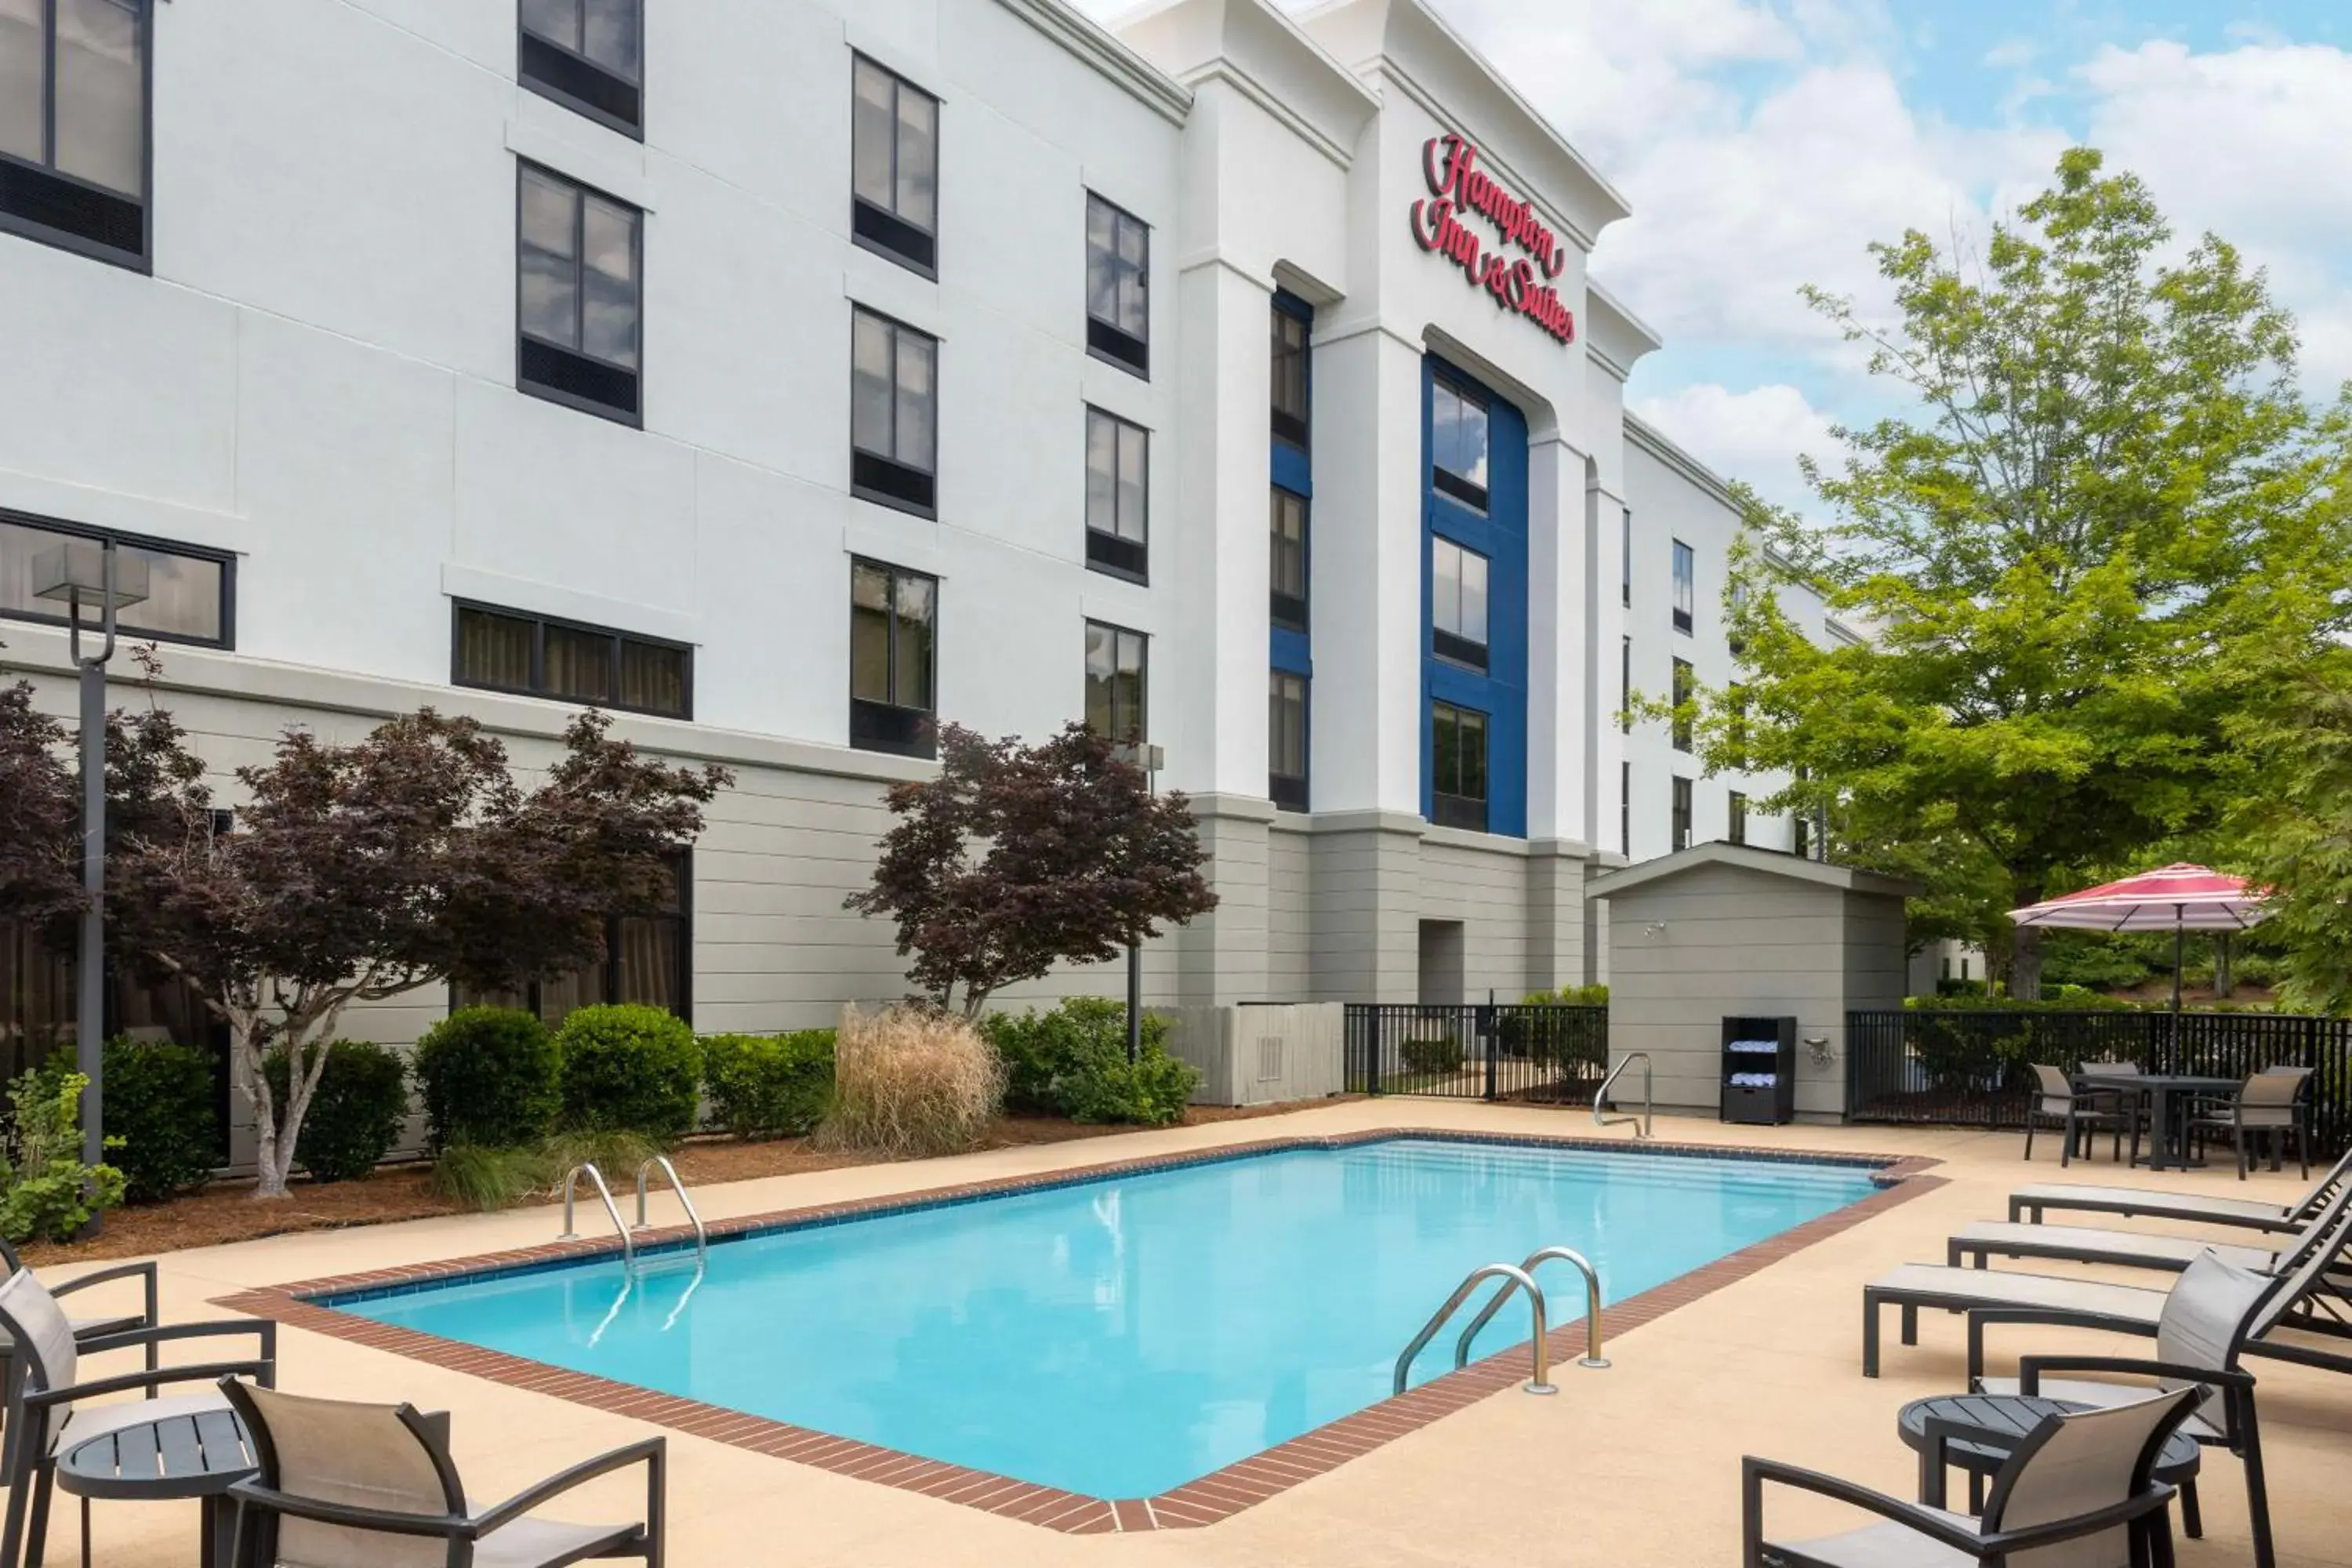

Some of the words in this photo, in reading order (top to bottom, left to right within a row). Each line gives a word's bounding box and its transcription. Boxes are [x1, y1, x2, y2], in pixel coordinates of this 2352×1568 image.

[1411, 198, 1491, 285] Inn
[1504, 259, 1575, 346] Suites
[1424, 132, 1565, 278] Hampton
